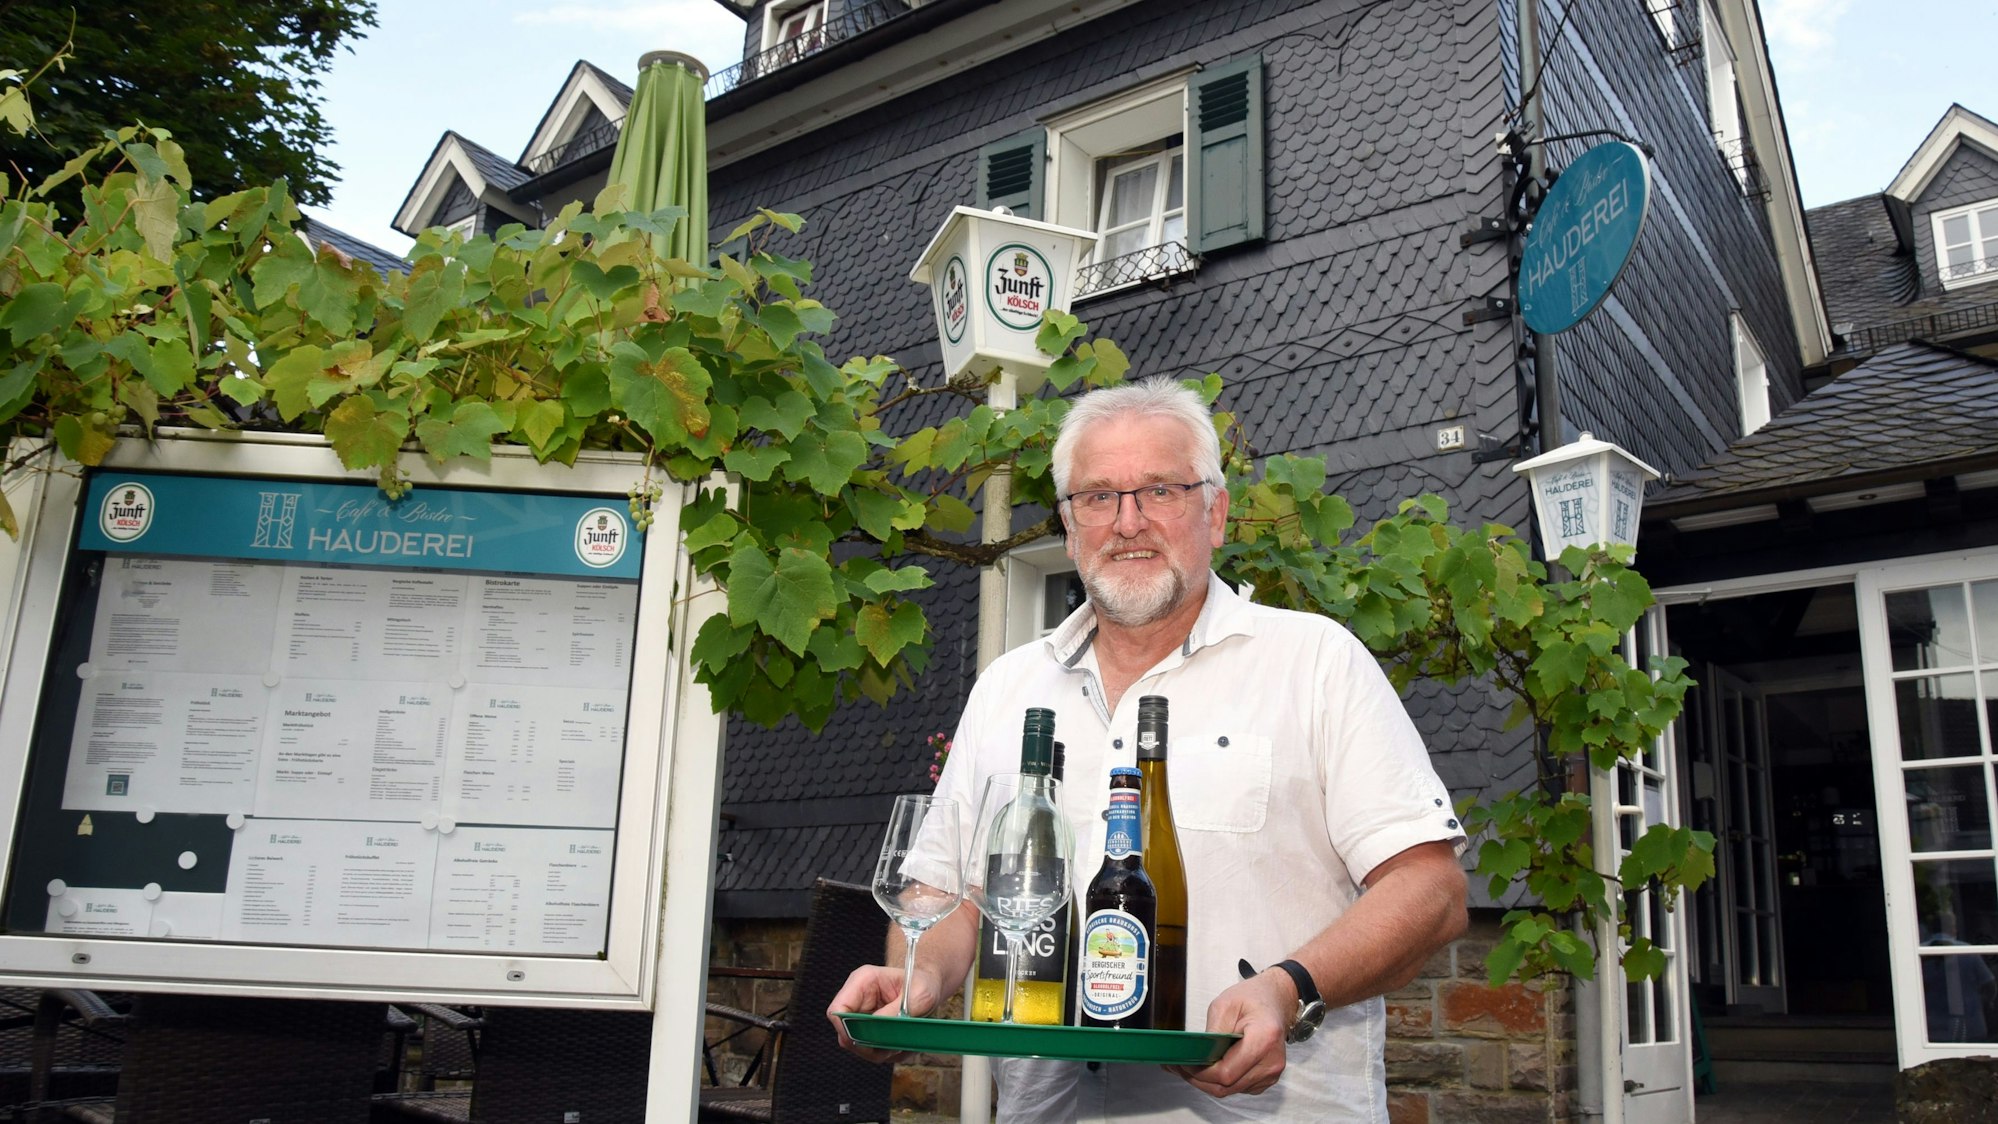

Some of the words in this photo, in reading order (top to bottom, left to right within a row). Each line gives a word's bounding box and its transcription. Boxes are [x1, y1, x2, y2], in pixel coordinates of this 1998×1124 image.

[1528, 178, 1629, 296] HAUDEREI
[994, 268, 1045, 299] Zunft
[1007, 295, 1039, 311] KÖLSCH
[1440, 430, 1460, 445] 34
[1545, 478, 1593, 496] HAUDEREI
[307, 527, 474, 558] HAUDEREI
[591, 543, 615, 552] KÖLSCH
[485, 579, 521, 587] Bistrokarte
[284, 710, 331, 718] Marktangebot
[993, 931, 1055, 957] LNG
[1091, 961, 1126, 969] BERGISCHER
[1086, 969, 1134, 981] Sportsfreund
